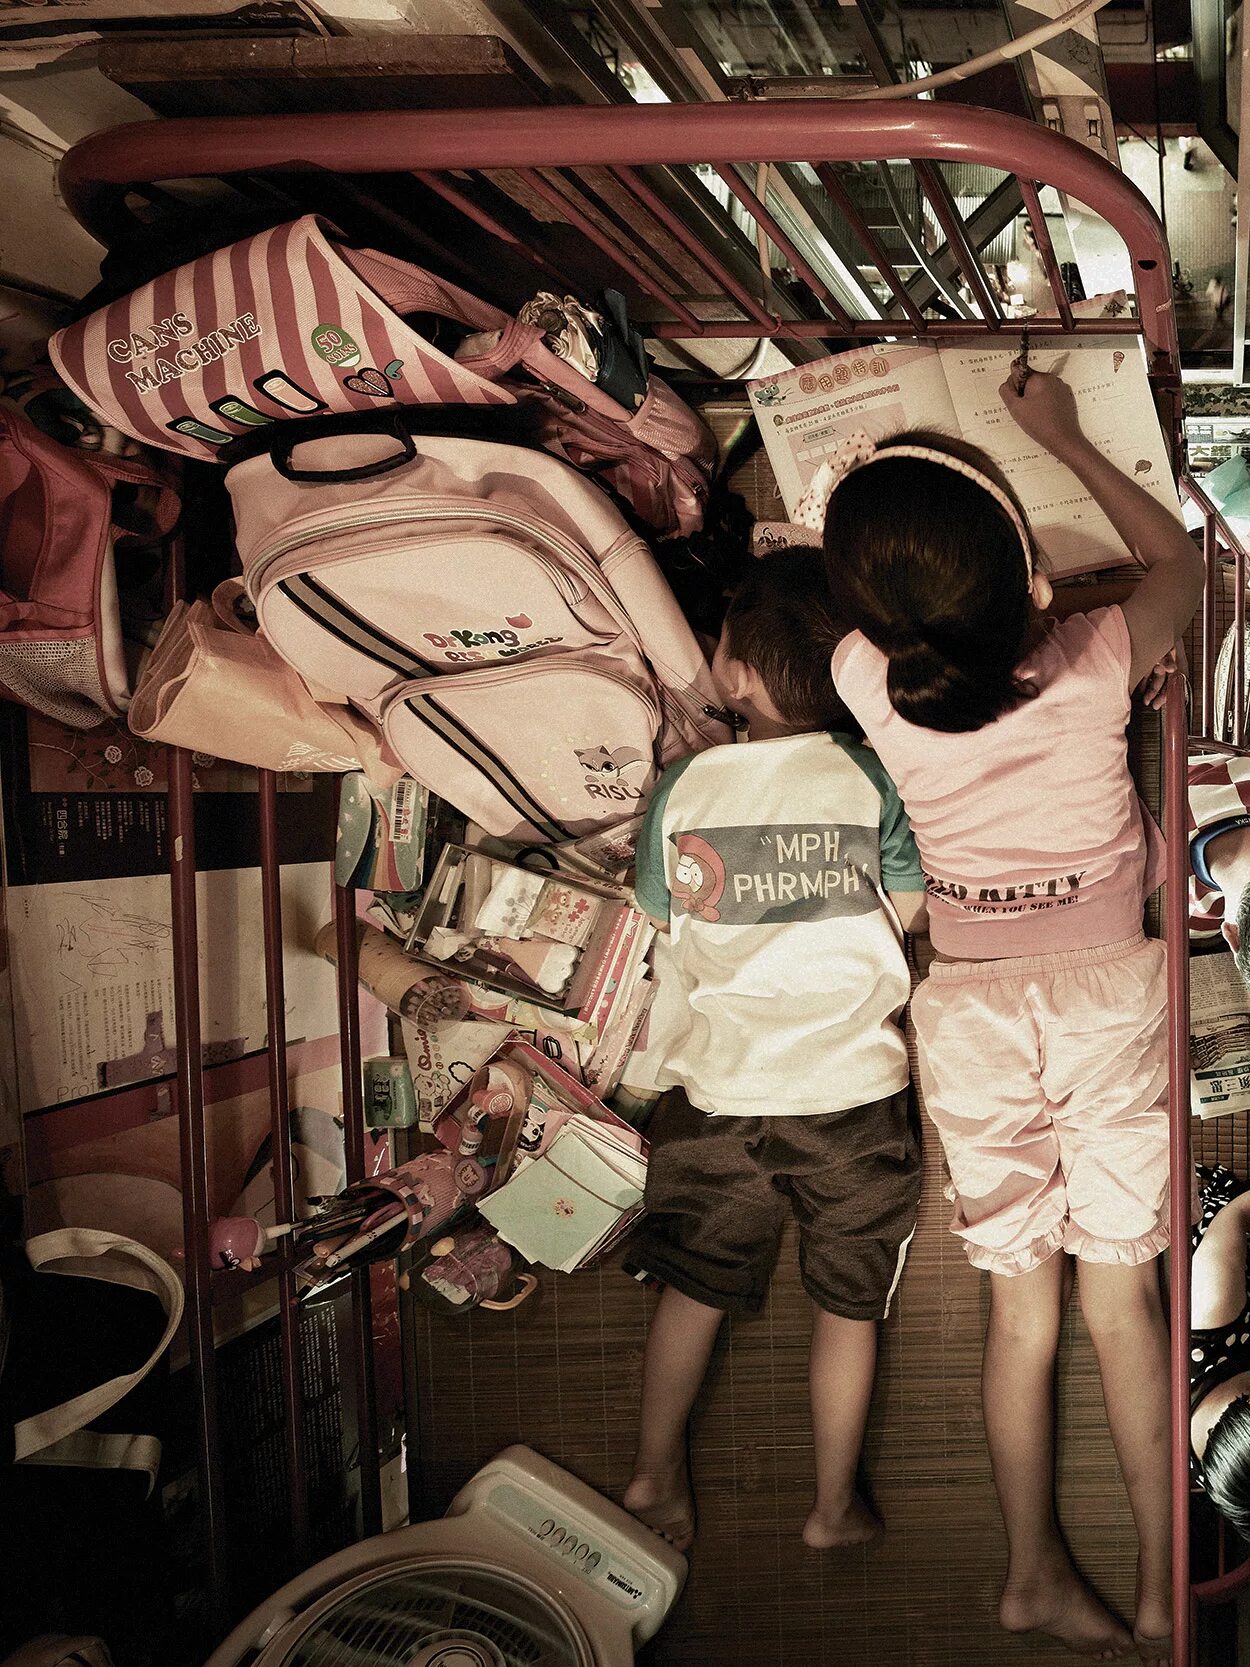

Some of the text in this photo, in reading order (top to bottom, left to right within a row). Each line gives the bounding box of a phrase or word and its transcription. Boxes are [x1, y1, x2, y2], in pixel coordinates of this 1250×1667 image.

[108, 312, 194, 363] CANS
[316, 329, 342, 354] 50
[125, 312, 262, 394] MACHINE
[326, 342, 359, 365] COINS
[584, 783, 645, 801] RISU
[1001, 904, 1027, 914] YOU
[1029, 901, 1054, 911] SEE
[1056, 895, 1079, 907] ME!
